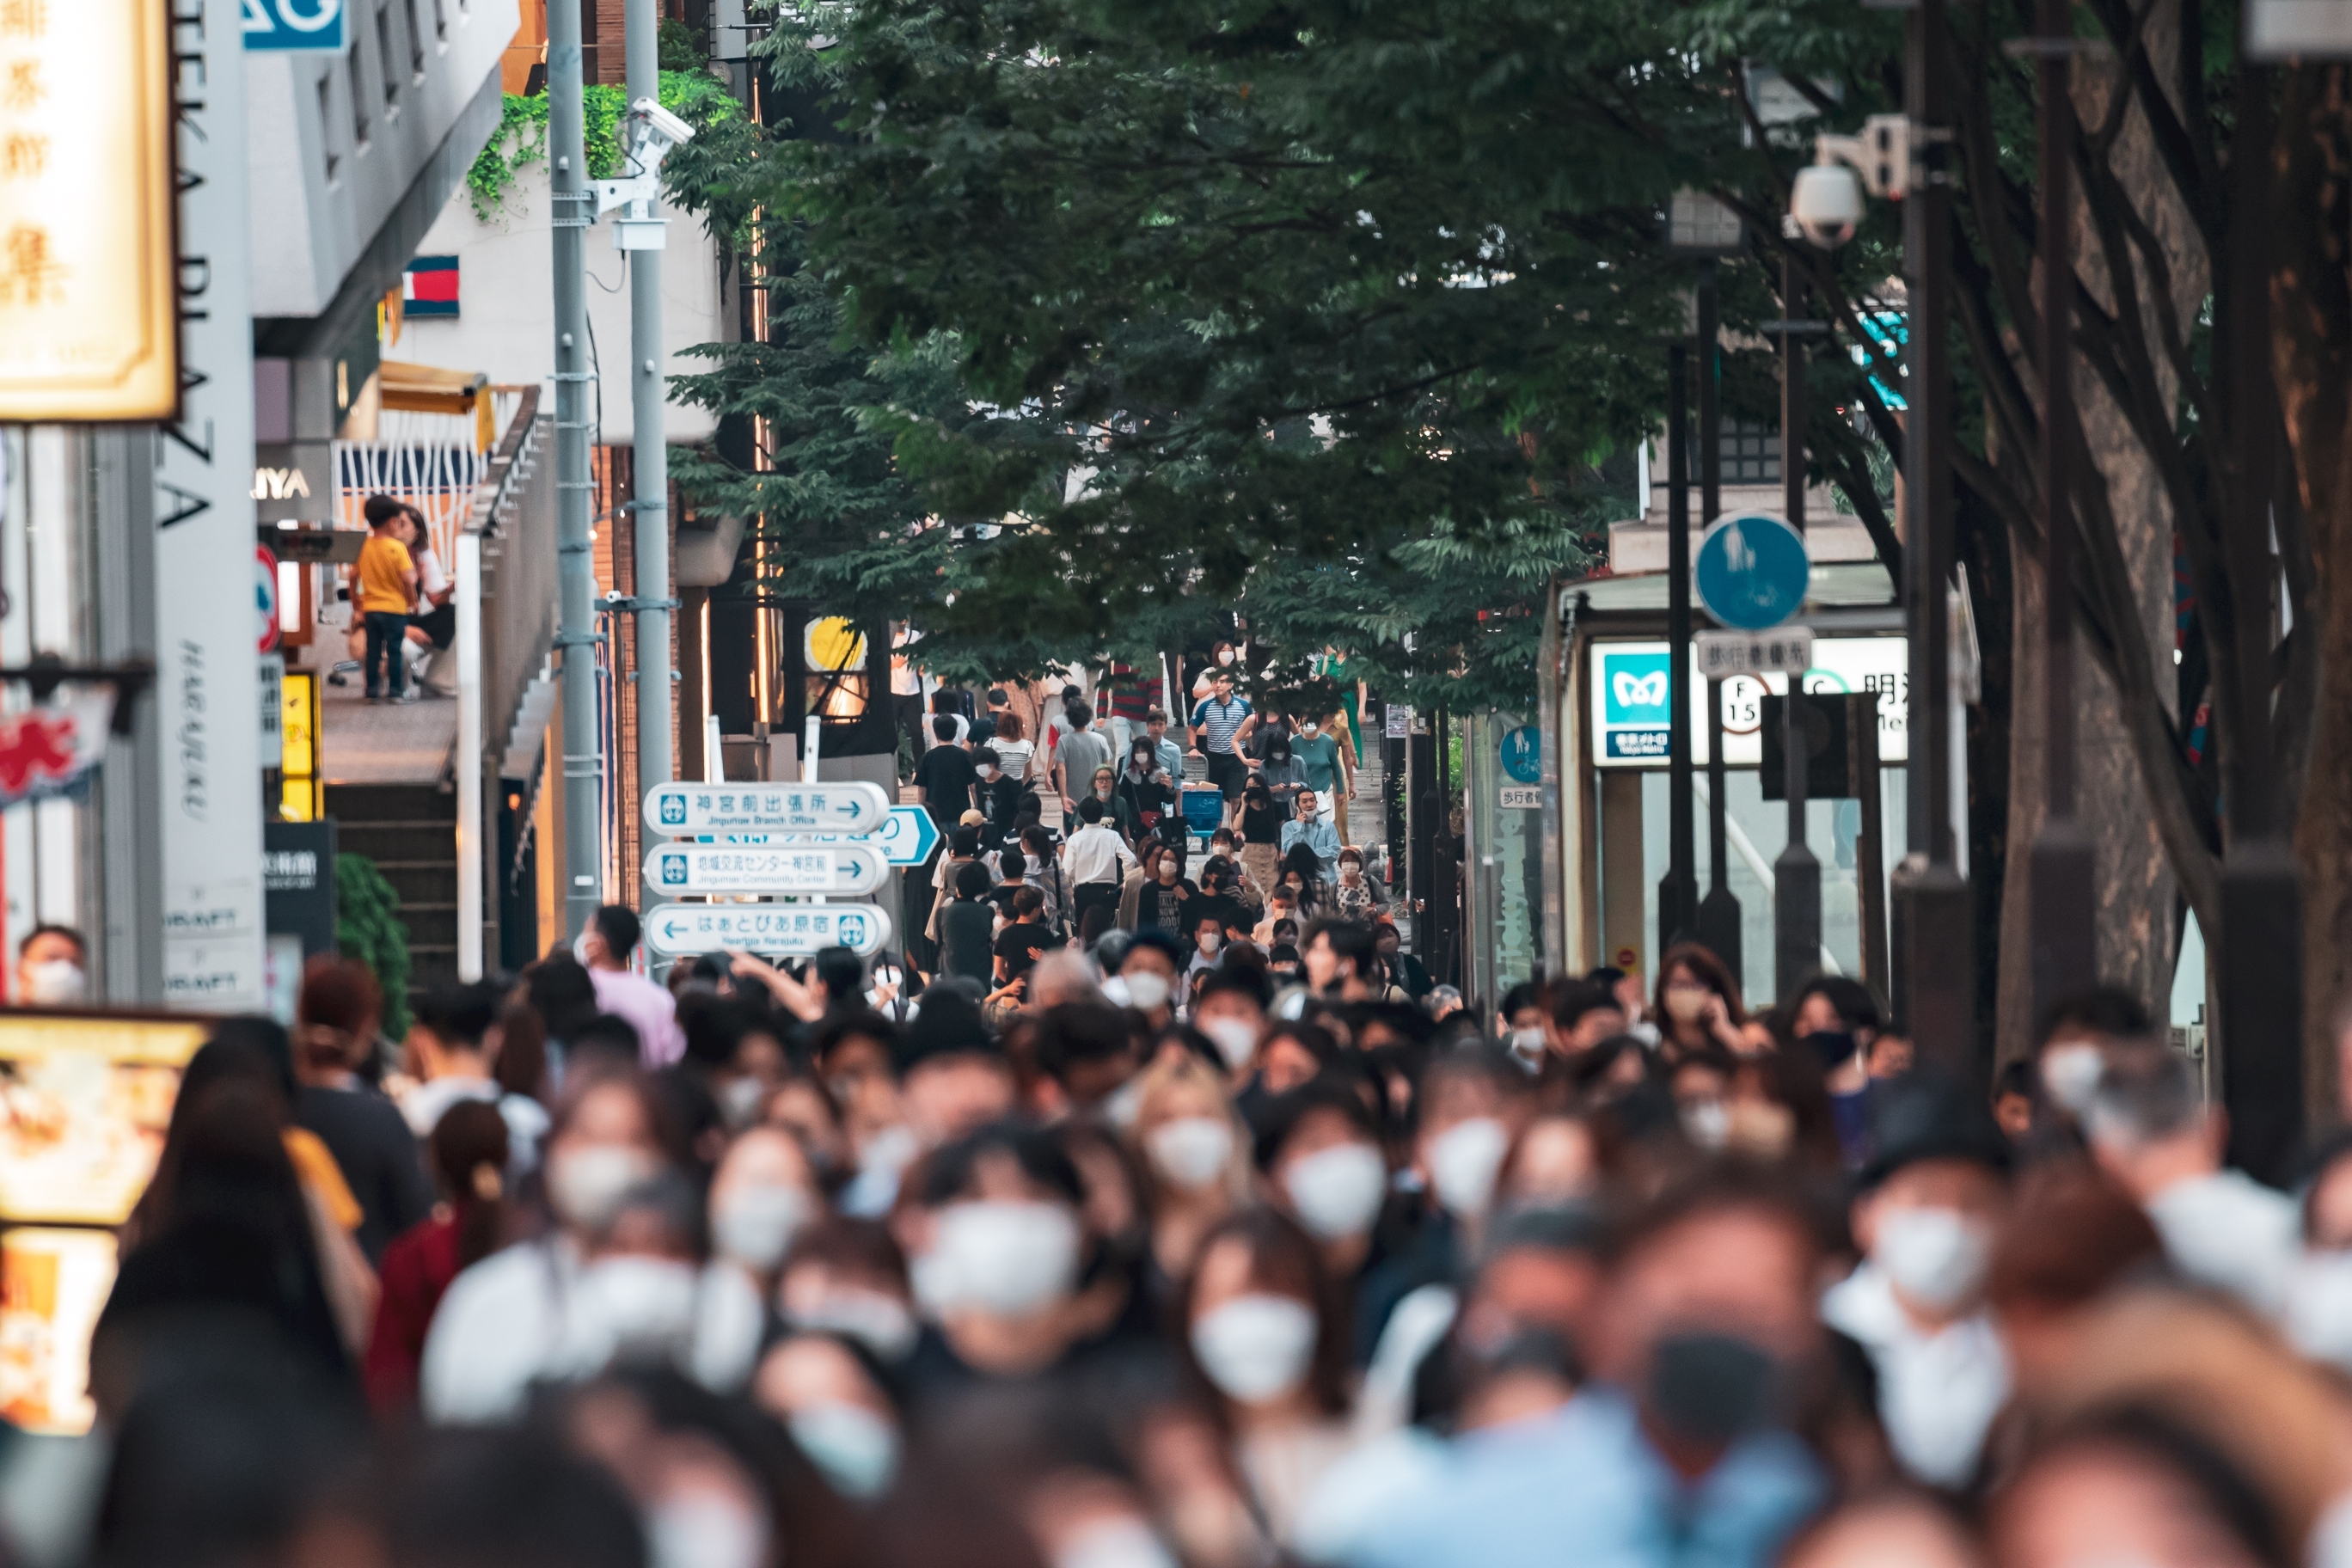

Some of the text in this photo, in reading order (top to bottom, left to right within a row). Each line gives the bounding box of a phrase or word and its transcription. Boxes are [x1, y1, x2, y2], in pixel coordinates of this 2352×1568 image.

[1736, 682, 1746, 698] F
[1865, 672, 1908, 705] 明
[1730, 703, 1755, 722] 15
[696, 793, 827, 813] 神宮前出張所
